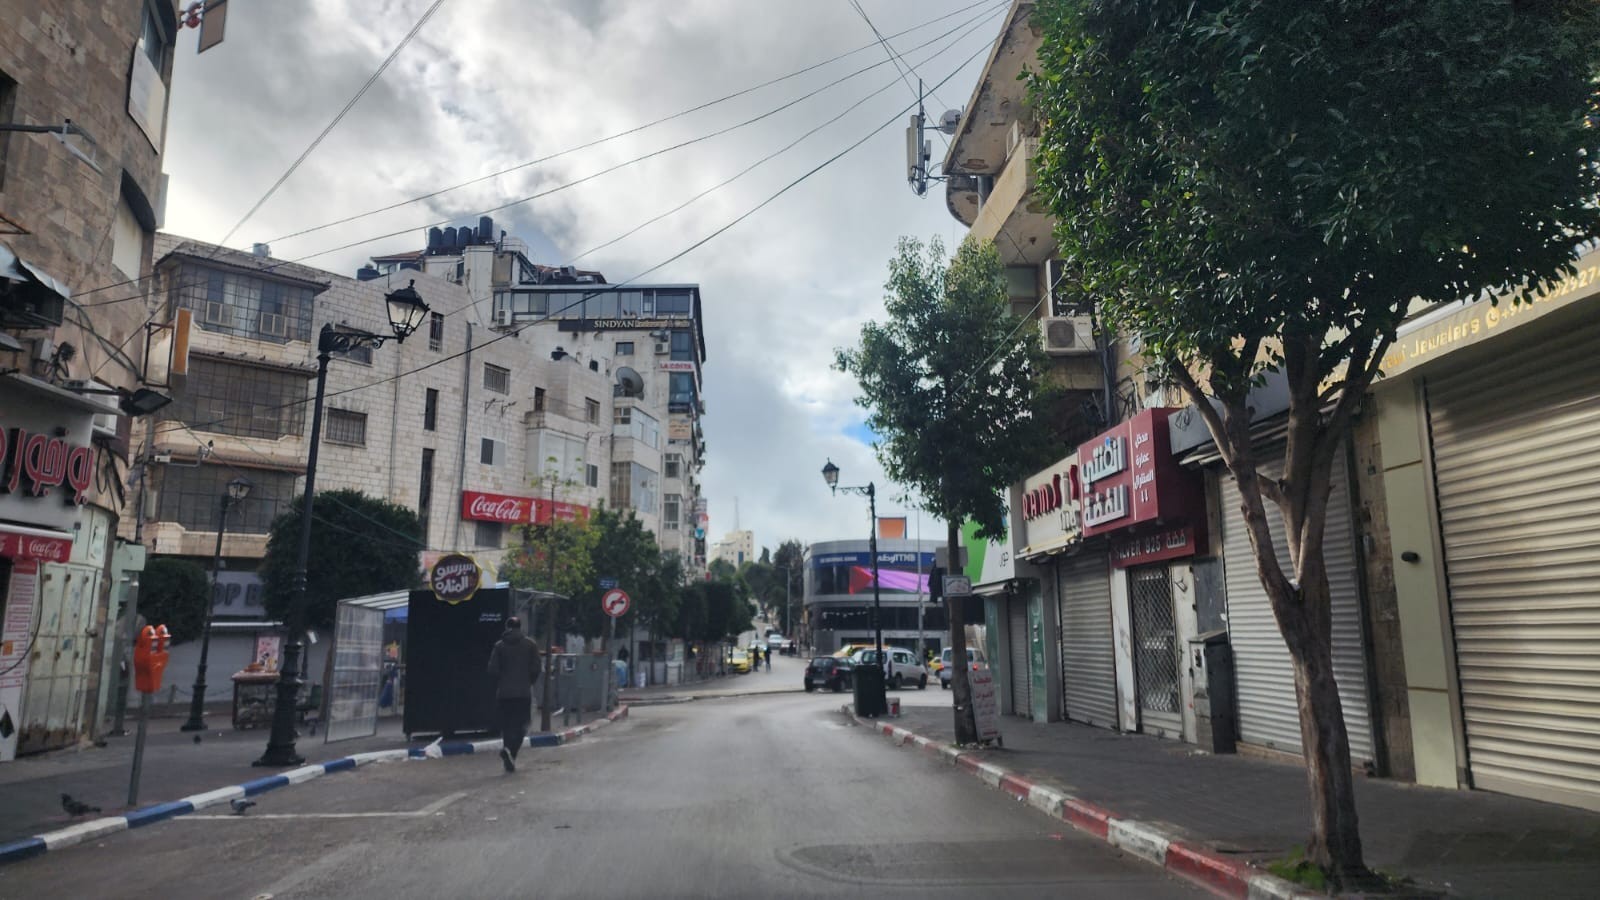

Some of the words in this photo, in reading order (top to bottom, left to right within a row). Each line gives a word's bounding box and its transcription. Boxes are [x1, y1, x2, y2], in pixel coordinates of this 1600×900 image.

[594, 320, 635, 328] SINDYAN
[1410, 317, 1480, 358] Jewelers
[470, 496, 522, 520] Coca-Cola
[1084, 484, 1128, 528] للفضة
[29, 539, 62, 559] Coca-Cola
